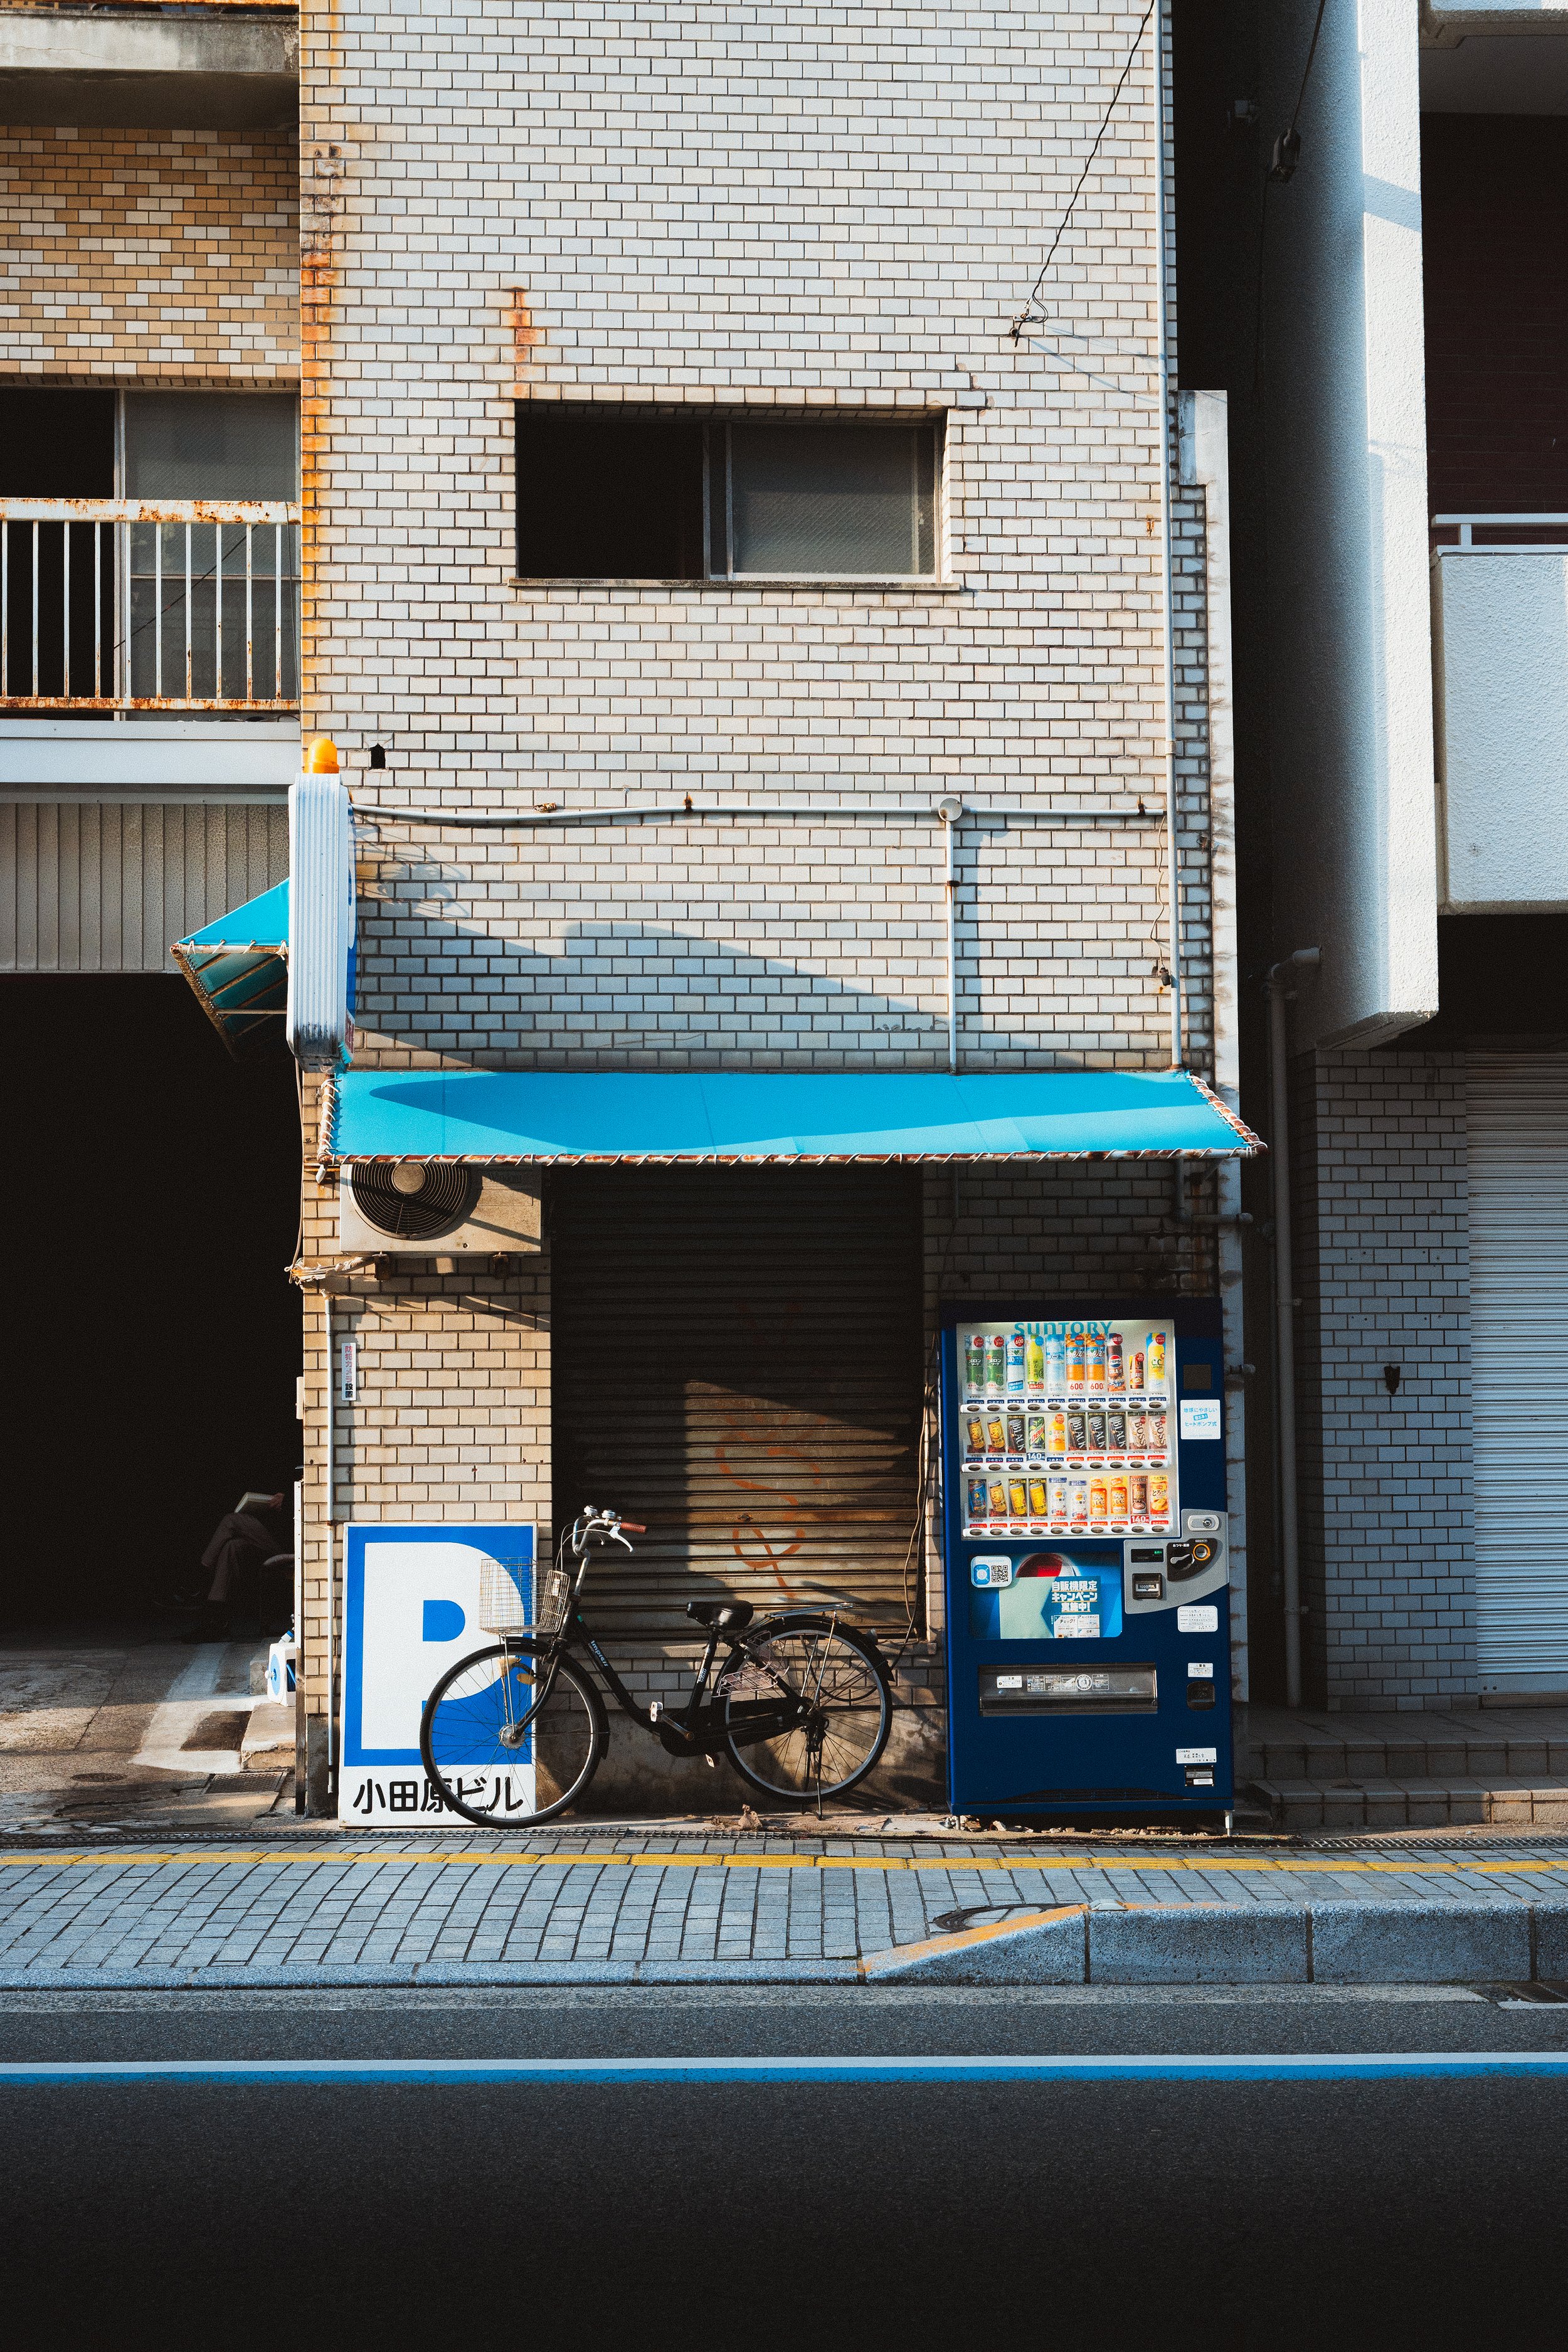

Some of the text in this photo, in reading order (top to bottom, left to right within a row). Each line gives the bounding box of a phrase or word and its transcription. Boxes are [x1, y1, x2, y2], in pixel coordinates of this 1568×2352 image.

[1014, 1322, 1113, 1335] SUNTORY
[345, 1345, 353, 1398] 防犯カメラ設置
[1012, 1422, 1025, 1451] BLACK
[1073, 1420, 1086, 1448] BLACK
[1093, 1420, 1106, 1448] BLACK
[1113, 1419, 1126, 1448] BLACK
[1135, 1420, 1147, 1445] BOSS
[1155, 1420, 1166, 1445] BOSS
[1051, 1592, 1098, 1601] キャンペーン
[1052, 1581, 1098, 1591] 自販機限定
[1061, 1602, 1091, 1611] 実施中!
[591, 1640, 609, 1666] Impress
